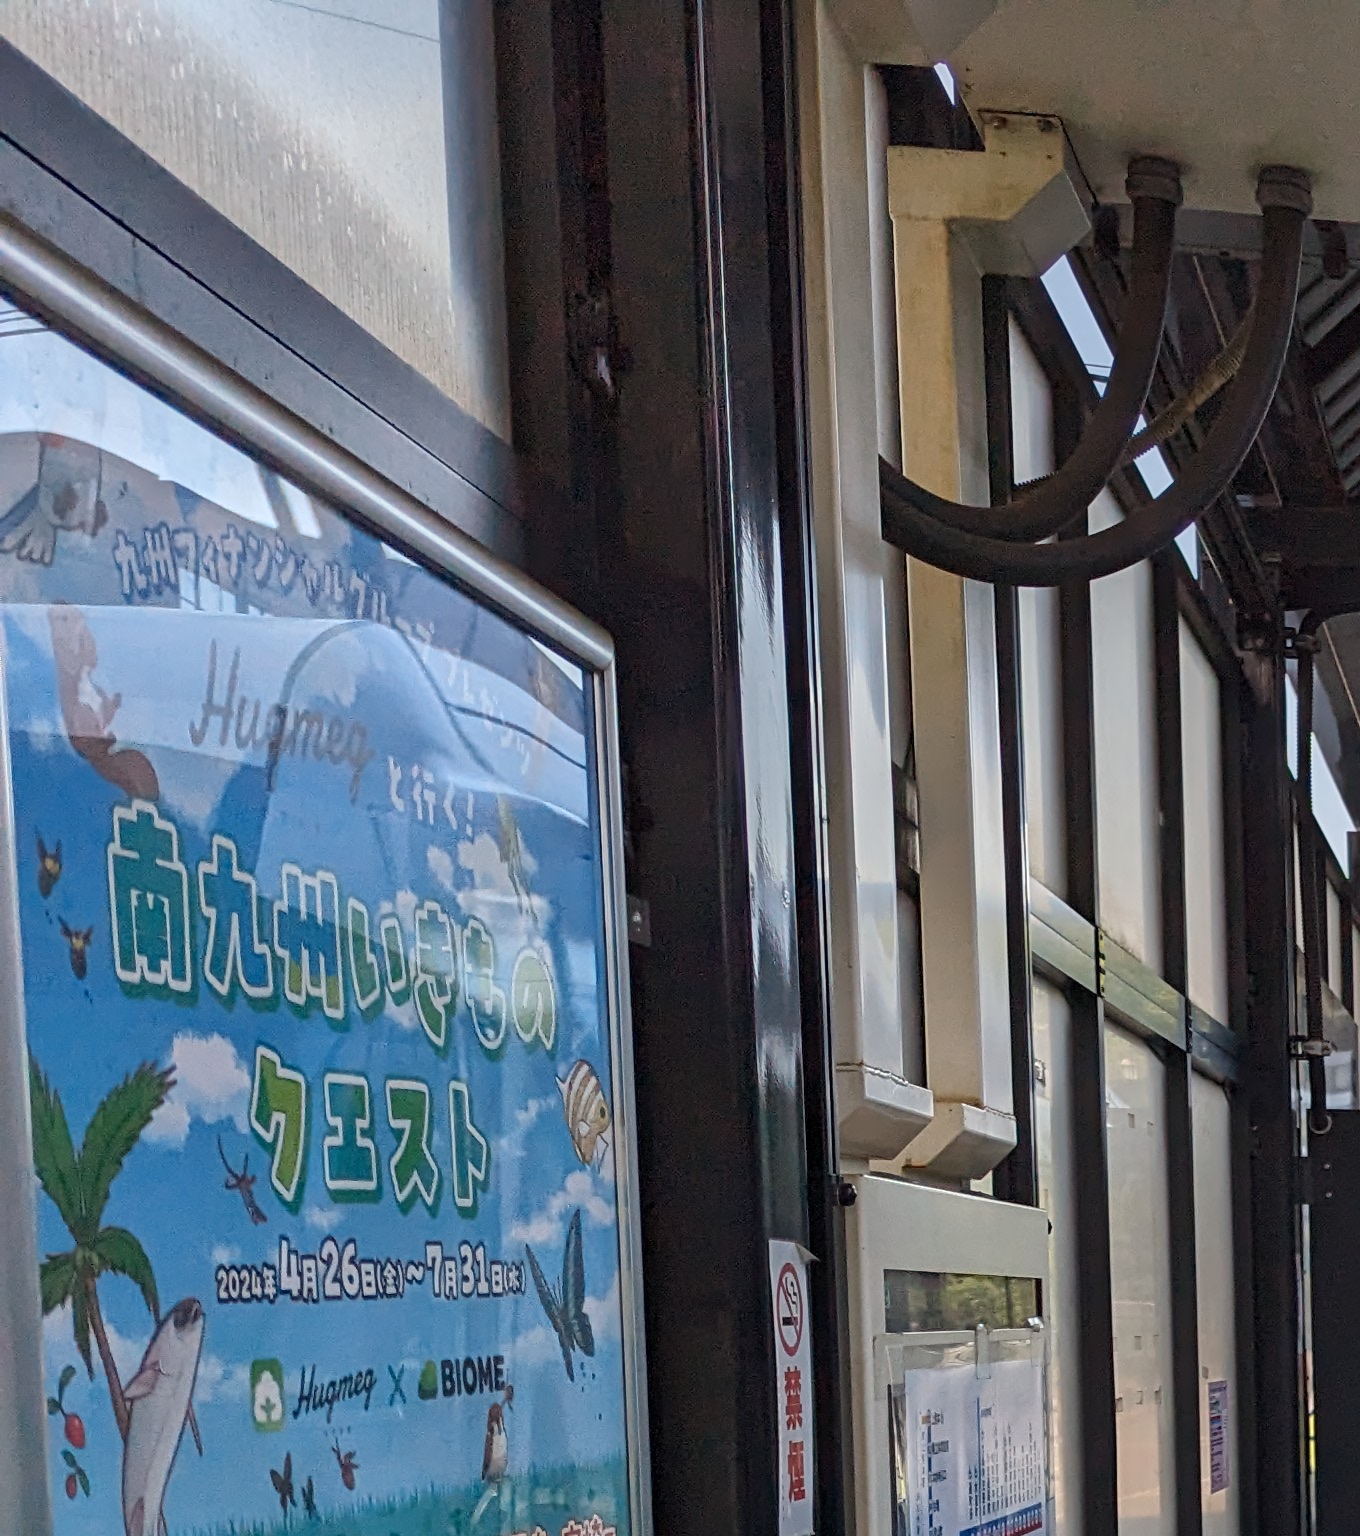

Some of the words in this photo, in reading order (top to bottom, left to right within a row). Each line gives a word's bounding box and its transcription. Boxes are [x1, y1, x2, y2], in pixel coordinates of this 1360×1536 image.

[107, 799, 559, 1052] 南九州いきもの
[250, 1045, 489, 1210] クエスト
[440, 1354, 506, 1398] BIOME
[783, 1366, 806, 1504] 禁煙
